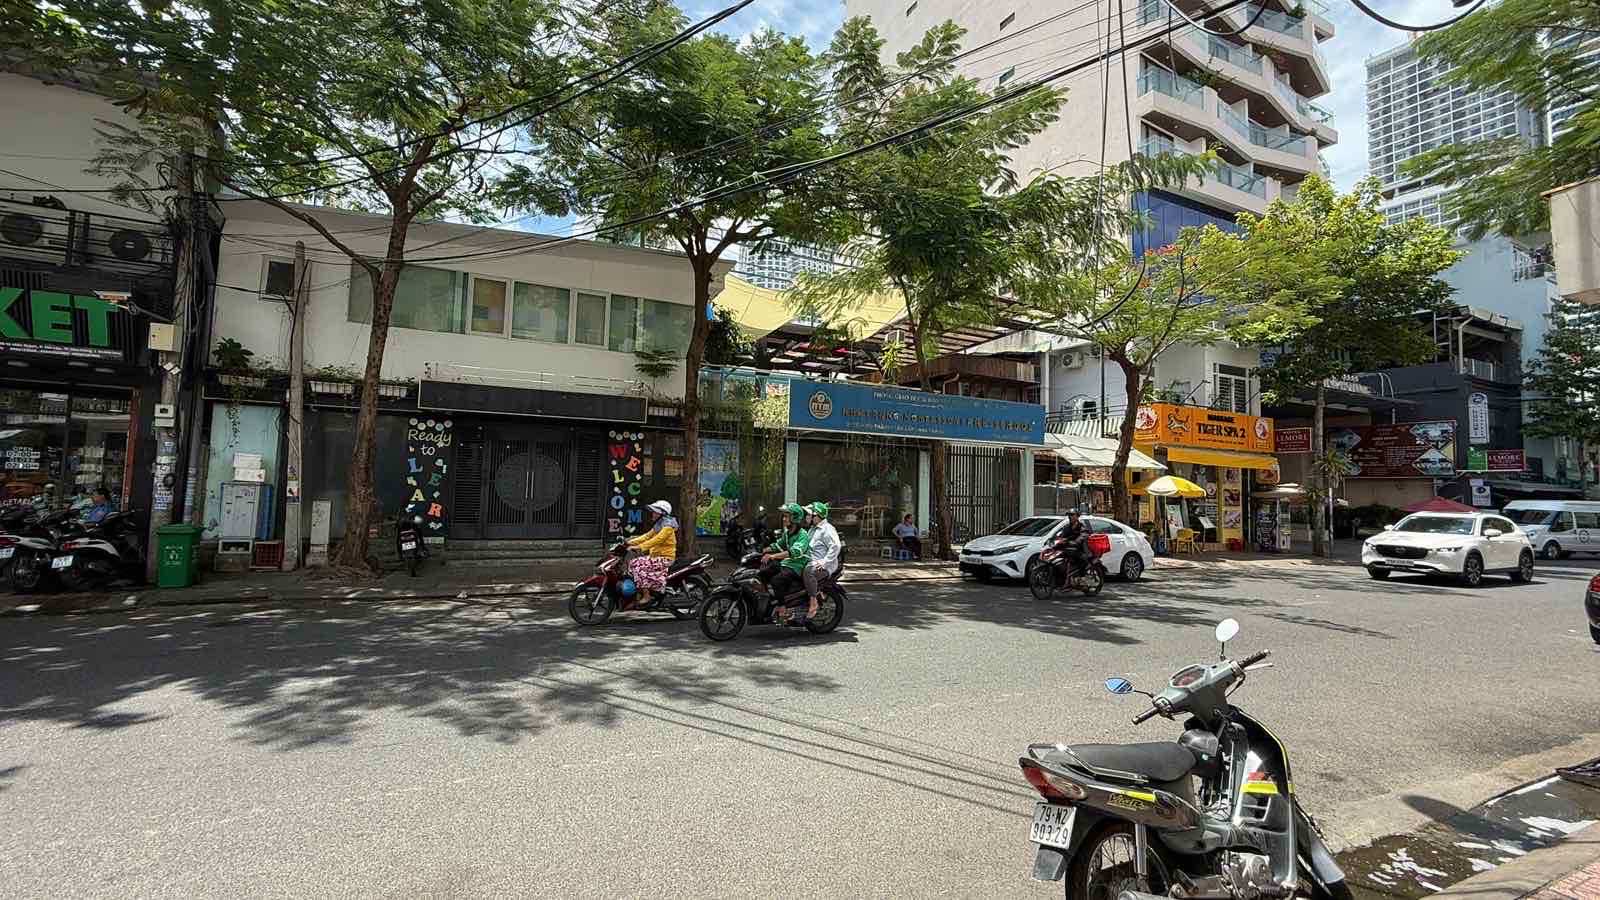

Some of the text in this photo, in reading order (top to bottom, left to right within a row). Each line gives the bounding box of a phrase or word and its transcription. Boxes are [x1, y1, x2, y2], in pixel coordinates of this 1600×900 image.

[407, 428, 451, 446] Ready
[1196, 422, 1223, 436] TIGER
[1239, 428, 1247, 438] 2
[420, 443, 436, 456] to
